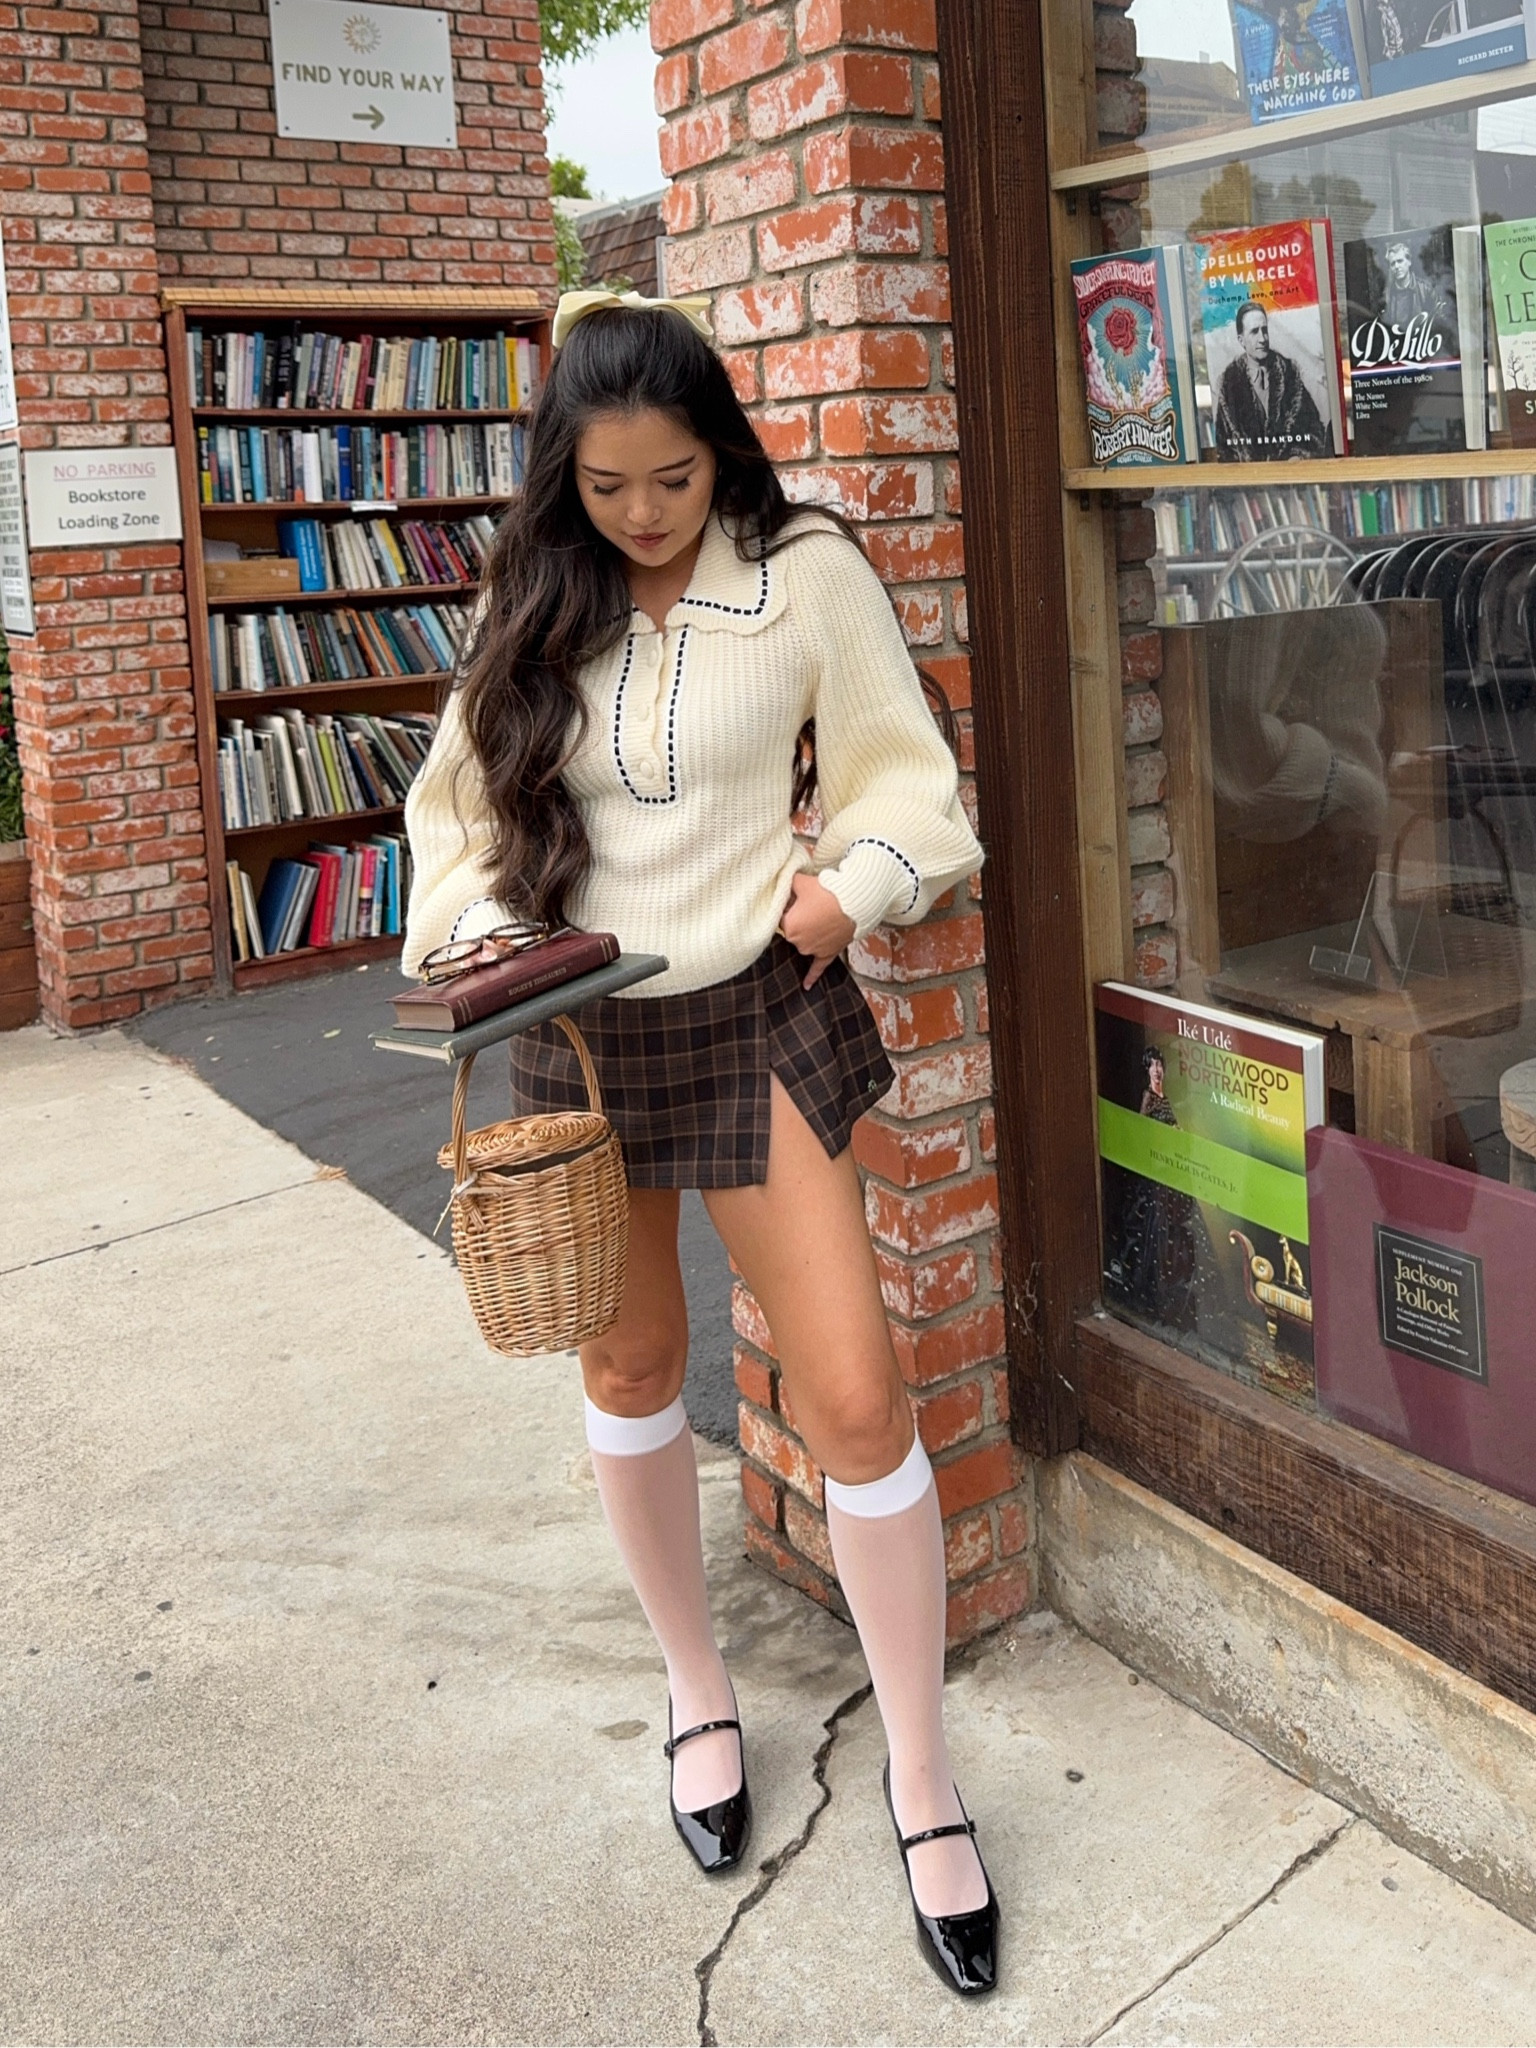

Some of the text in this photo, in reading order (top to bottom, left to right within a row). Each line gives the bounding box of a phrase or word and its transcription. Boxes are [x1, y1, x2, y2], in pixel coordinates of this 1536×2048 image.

[1458, 45, 1514, 65] RICHARD MEYER
[282, 62, 444, 93] FIND YOUR WAY
[1247, 66, 1350, 95] THEIR EYES WERE
[1263, 86, 1356, 112] WATCHING GOD
[1495, 239, 1507, 247] THE
[1200, 242, 1301, 271] SPELLBOUND
[1208, 263, 1296, 289] BY MARCEL
[1208, 286, 1299, 306] Duchamp, Love, and Art
[1351, 311, 1443, 370] DeLillo
[1354, 373, 1433, 388] Three Novels of the 1980s
[1354, 392, 1386, 402] The Names
[1354, 401, 1389, 410] White Noise
[1355, 411, 1371, 420] Libra
[1092, 422, 1176, 460] ROBERT HUNTER
[1226, 433, 1311, 446] RUTH BRANDON
[53, 461, 156, 478] NO PARKING
[69, 488, 146, 504] Bookstore
[58, 513, 160, 530] Loading Zone
[1177, 1017, 1232, 1051] Iké Udé
[1179, 1042, 1289, 1092] NOLLYWOOD
[1179, 1060, 1268, 1105] PORTRAITS
[1209, 1091, 1290, 1130] A Radical Beauty
[1150, 1149, 1174, 1167] HENRY
[1176, 1160, 1200, 1177] LOUIS
[1392, 1247, 1426, 1263] SUPPLEMENT
[1427, 1259, 1450, 1271] NUMBER
[1394, 1257, 1459, 1297] Jackson
[1395, 1281, 1460, 1323] Pollock
